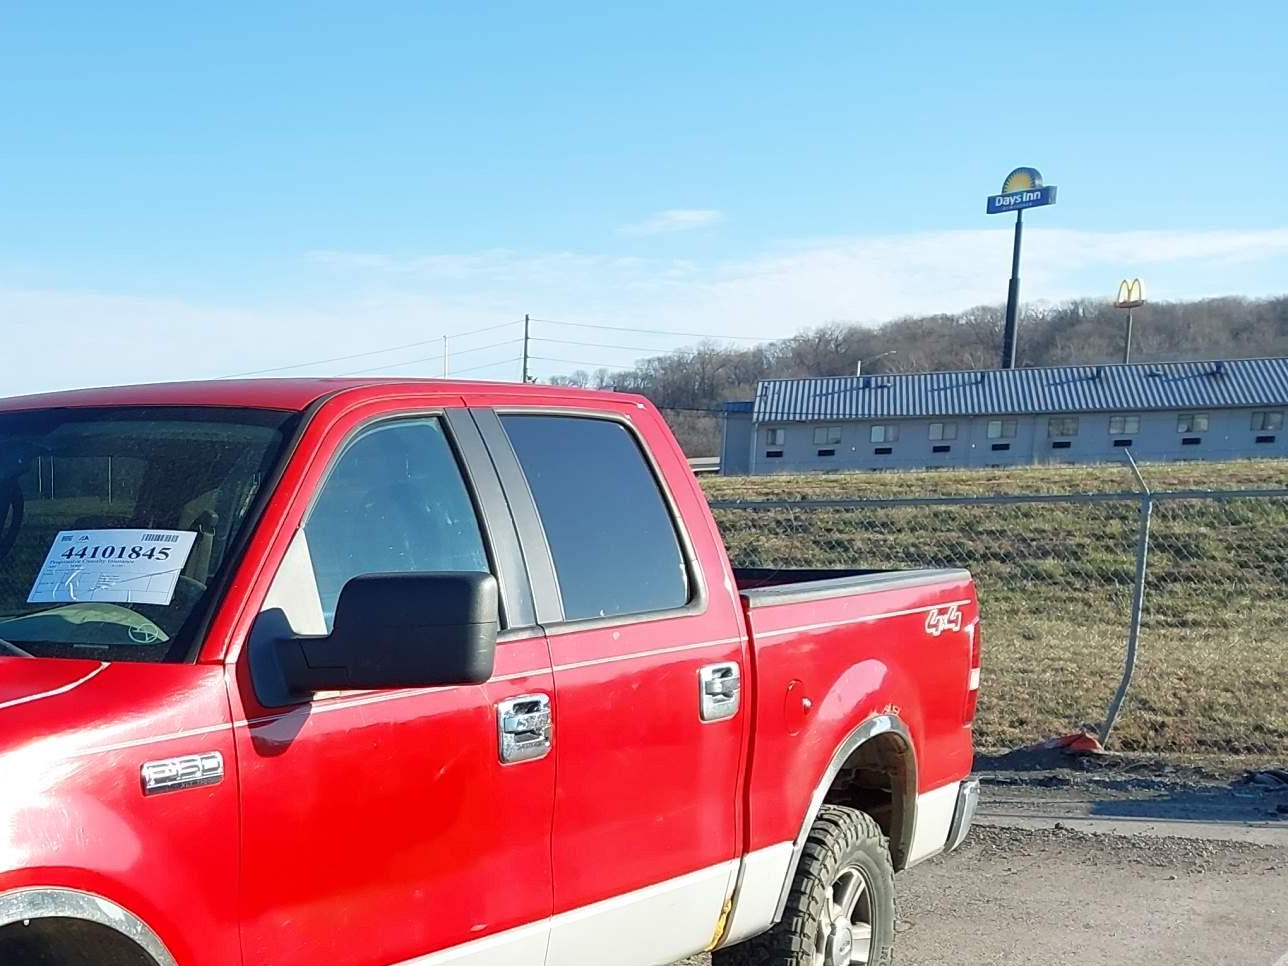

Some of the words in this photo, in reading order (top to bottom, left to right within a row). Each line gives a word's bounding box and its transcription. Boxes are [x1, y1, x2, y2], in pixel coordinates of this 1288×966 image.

[995, 195, 1022, 207] Days
[1023, 191, 1041, 202] Inn
[61, 545, 173, 561] 44101845
